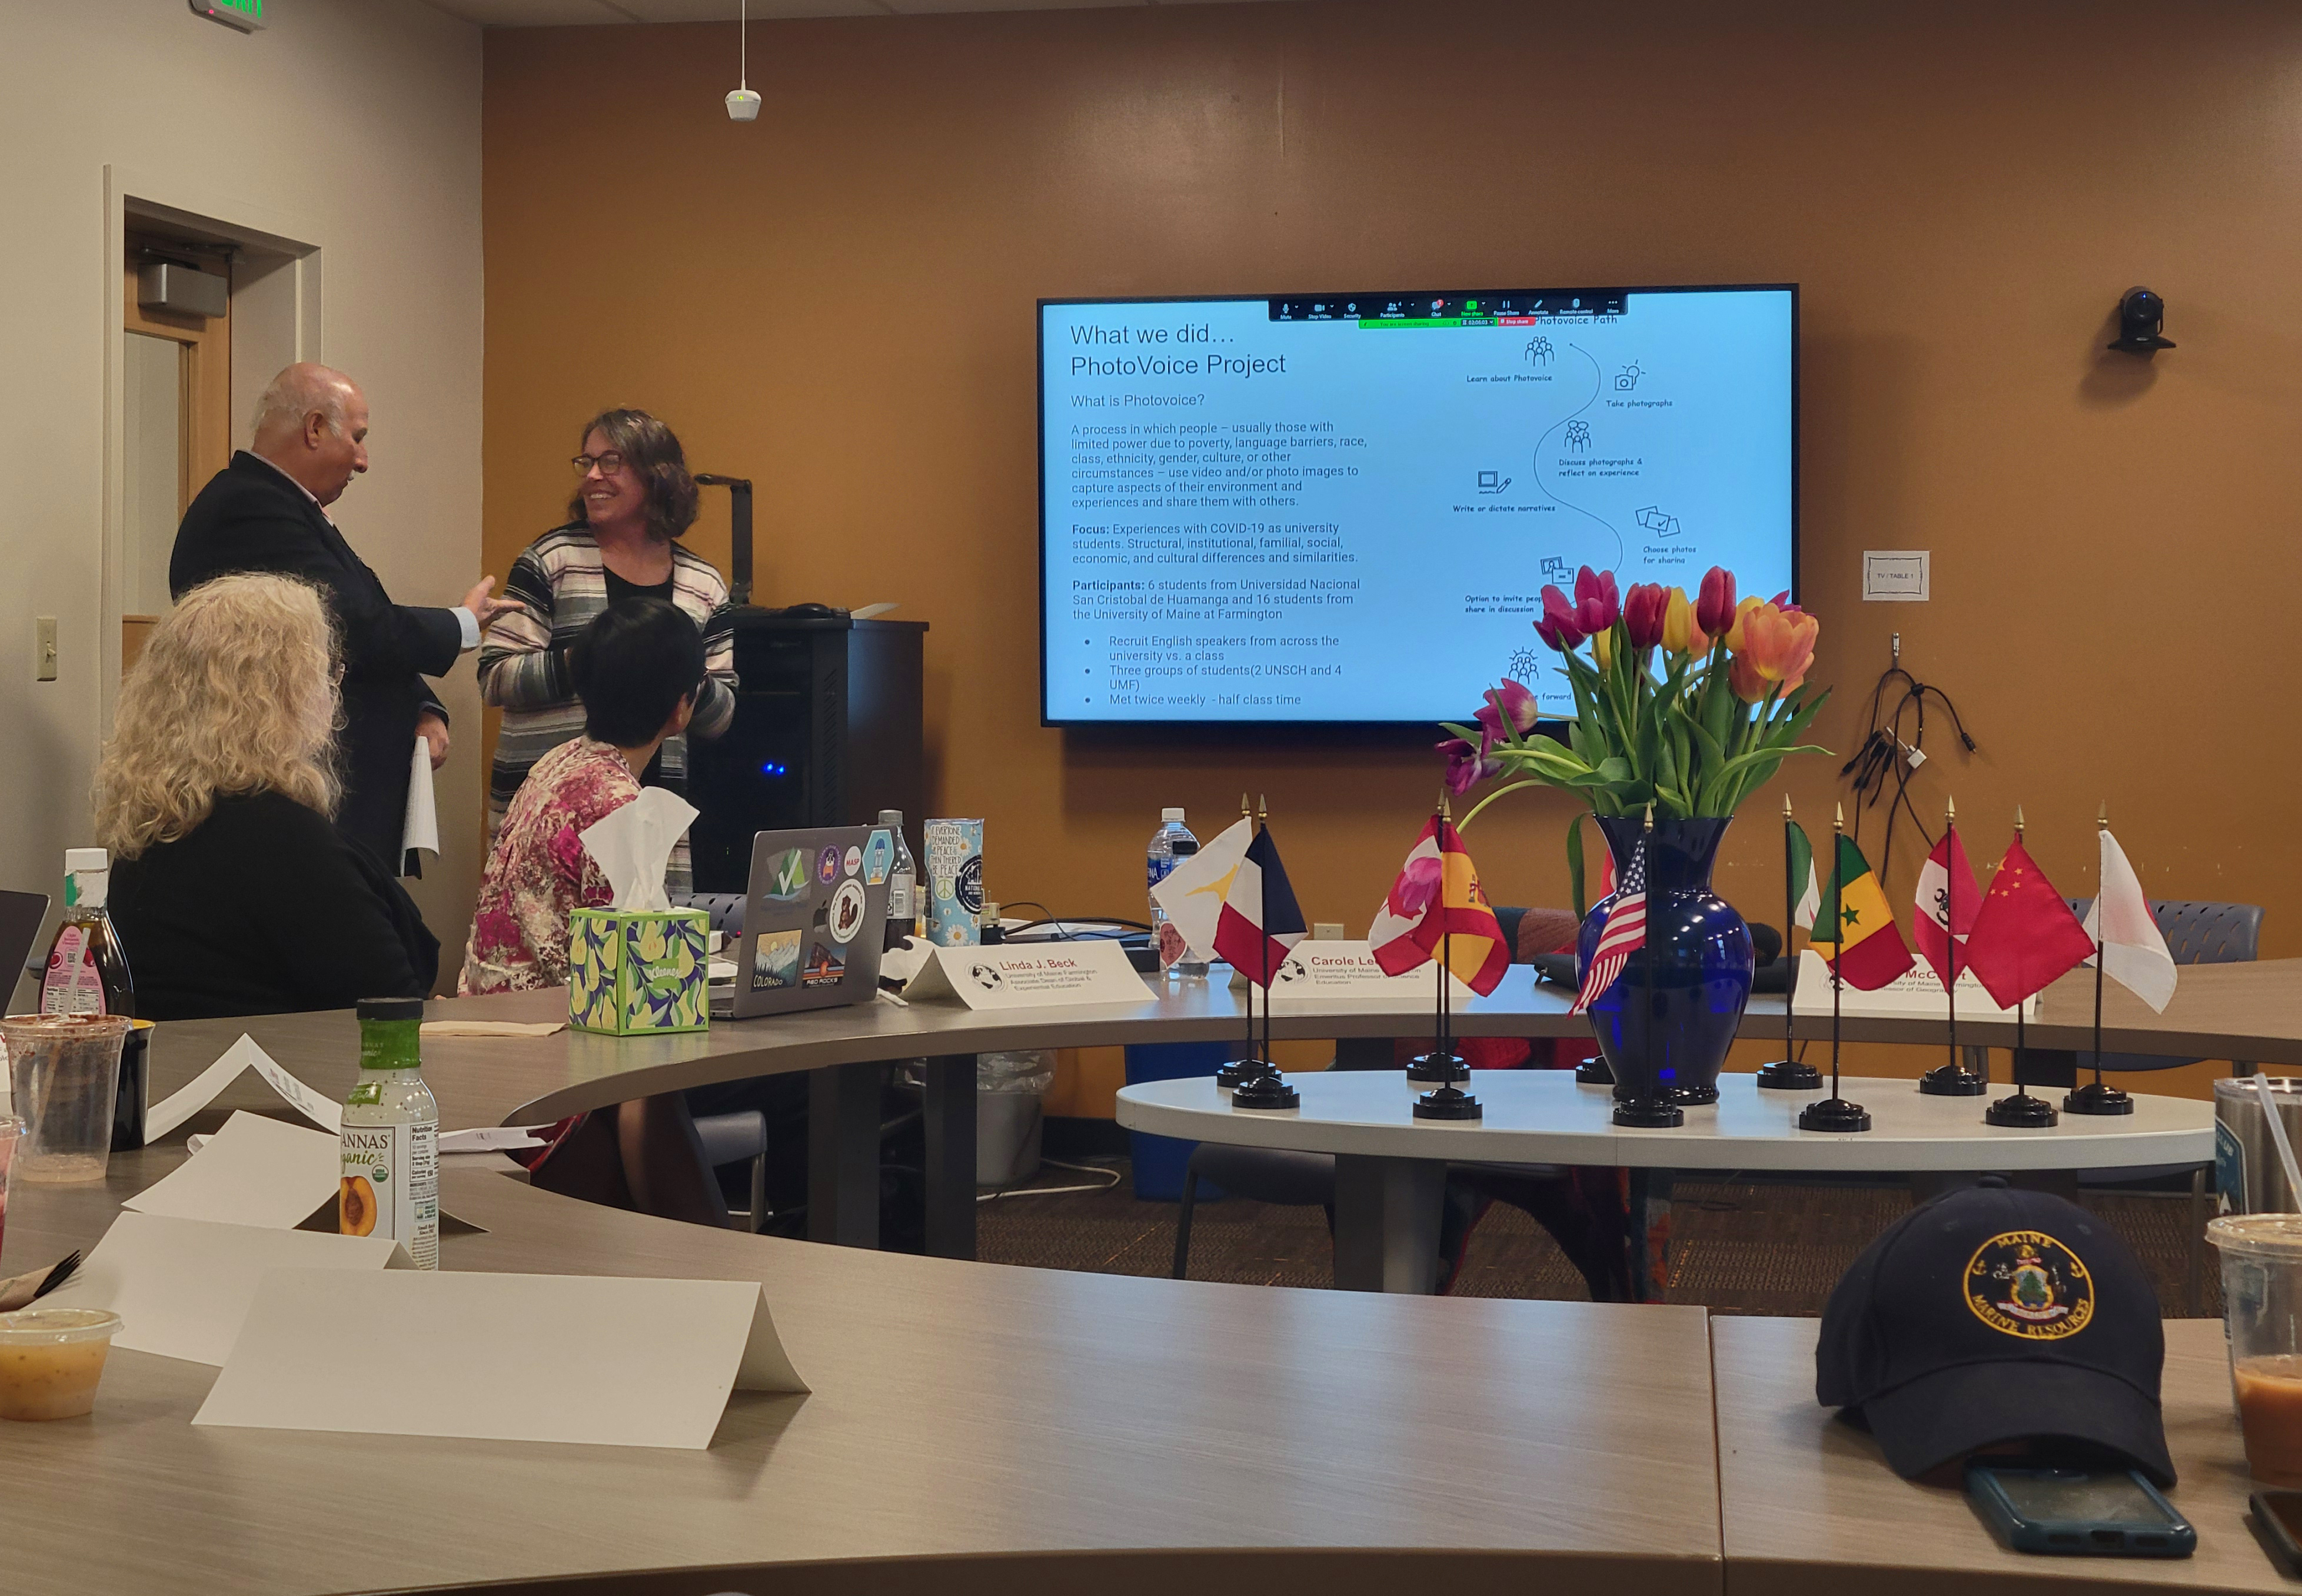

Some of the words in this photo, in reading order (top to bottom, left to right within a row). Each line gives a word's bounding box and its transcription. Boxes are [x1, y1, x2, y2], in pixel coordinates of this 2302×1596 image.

[1594, 315, 1618, 324] Path
[1070, 324, 1129, 345] What
[1136, 328, 1168, 344] we
[1072, 354, 1198, 377] PhotoVoice
[1207, 353, 1286, 379] Project
[1466, 374, 1488, 383] Learn
[1490, 374, 1511, 383] about
[1513, 374, 1552, 383] Photovoice
[1071, 394, 1106, 408] What
[1109, 394, 1120, 407] is
[1125, 393, 1205, 407] Photovoice?
[1605, 399, 1624, 407] Take
[1627, 398, 1672, 409] photographs
[1072, 437, 1109, 451] limited
[1113, 440, 1148, 453] power
[1150, 436, 1172, 450] due
[1174, 438, 1185, 449] to
[1188, 437, 1232, 451] poverty,
[1235, 436, 1288, 451] language
[1290, 435, 1336, 448] barriers,
[1340, 438, 1367, 448] race,
[1072, 451, 1103, 467] class,
[1106, 450, 1156, 467] ethnicity,
[1159, 451, 1200, 466] gender,
[1202, 451, 1244, 464] culture,
[1246, 453, 1259, 463] or
[1261, 450, 1292, 463] other
[1559, 458, 1586, 466] Discuss
[1589, 457, 1634, 468] photographs
[1558, 468, 1585, 477] reflect
[1599, 468, 1639, 478] experience
[1072, 481, 1114, 496] capture
[1117, 482, 1161, 496] aspects
[1165, 481, 1177, 494] of
[1179, 480, 1205, 494] their
[1207, 479, 1279, 493] environment
[1281, 480, 1302, 493] and
[1072, 495, 1139, 511] experiences
[1142, 495, 1163, 508] and
[1166, 494, 1197, 507] share
[1200, 494, 1229, 507] them
[1232, 494, 1256, 507] with
[1259, 494, 1298, 507] others.
[1453, 504, 1475, 513] Write
[1488, 504, 1515, 513] dictate
[1518, 504, 1556, 513] narratives
[1072, 523, 1109, 536] Focus:
[1113, 523, 1180, 538] Experiences
[1183, 522, 1207, 536] with
[1210, 522, 1265, 535] COVID-19
[1268, 524, 1282, 534] as
[1285, 522, 1339, 536] university
[1643, 545, 1669, 554] Choose
[1671, 545, 1696, 555] photos
[1643, 556, 1655, 564] for
[1658, 556, 1685, 564] sharing
[1073, 579, 1145, 594] Participants:
[1148, 579, 1155, 591] 6
[1158, 579, 1207, 591] students
[1210, 578, 1237, 591] from
[1240, 578, 1306, 591] Universidad
[1310, 578, 1360, 590] Nacional
[1465, 594, 1489, 604] Option
[1503, 594, 1523, 603] invite
[1465, 604, 1486, 613] share
[1488, 605, 1495, 613] in
[1498, 604, 1534, 613] discussion
[1109, 635, 1149, 648] Recruit
[1152, 634, 1192, 650] English
[1195, 634, 1246, 650] speakers
[1250, 635, 1276, 647] from
[1280, 637, 1318, 647] across
[1321, 634, 1339, 647] the
[936, 826, 960, 835] EVERYONE
[932, 836, 960, 846] DEMANDED
[937, 846, 953, 855] PEACE
[940, 864, 959, 876] PEACE
[999, 961, 1033, 970] Linda
[1036, 960, 1046, 969] J.
[1047, 958, 1077, 968] Beck
[1311, 956, 1354, 966] Carole
[650, 966, 683, 979] Kleenex
[753, 975, 783, 987] COLORADO
[342, 1133, 389, 1149] ANNAS
[341, 1150, 378, 1175] ganic
[1996, 1233, 2052, 1248] MAINE
[1972, 1294, 2020, 1332] MARINE
[2027, 1298, 2090, 1336] RESOURCES
